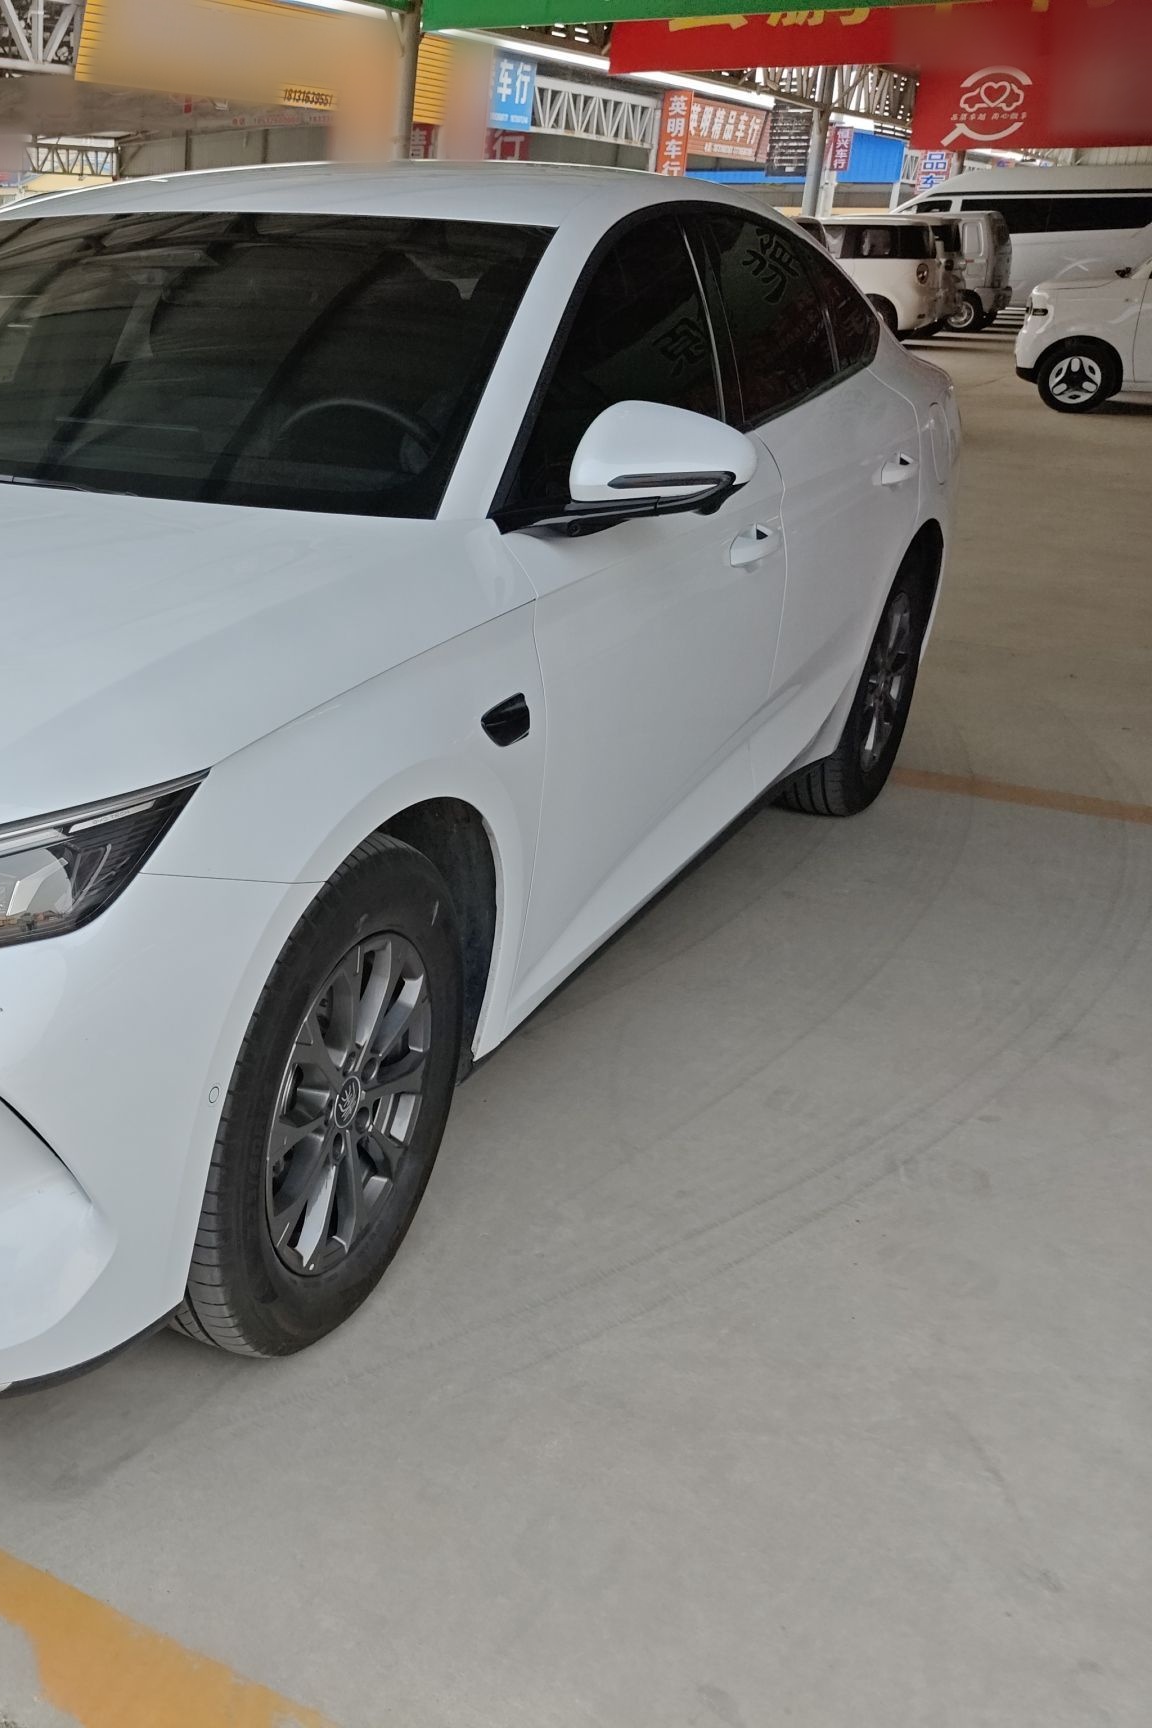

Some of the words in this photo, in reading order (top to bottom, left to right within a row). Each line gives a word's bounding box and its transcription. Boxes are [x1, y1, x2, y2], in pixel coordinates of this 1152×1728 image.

[496, 59, 532, 104] 车行
[662, 95, 688, 176] 英明车行
[689, 102, 761, 145] 英明精品车行
